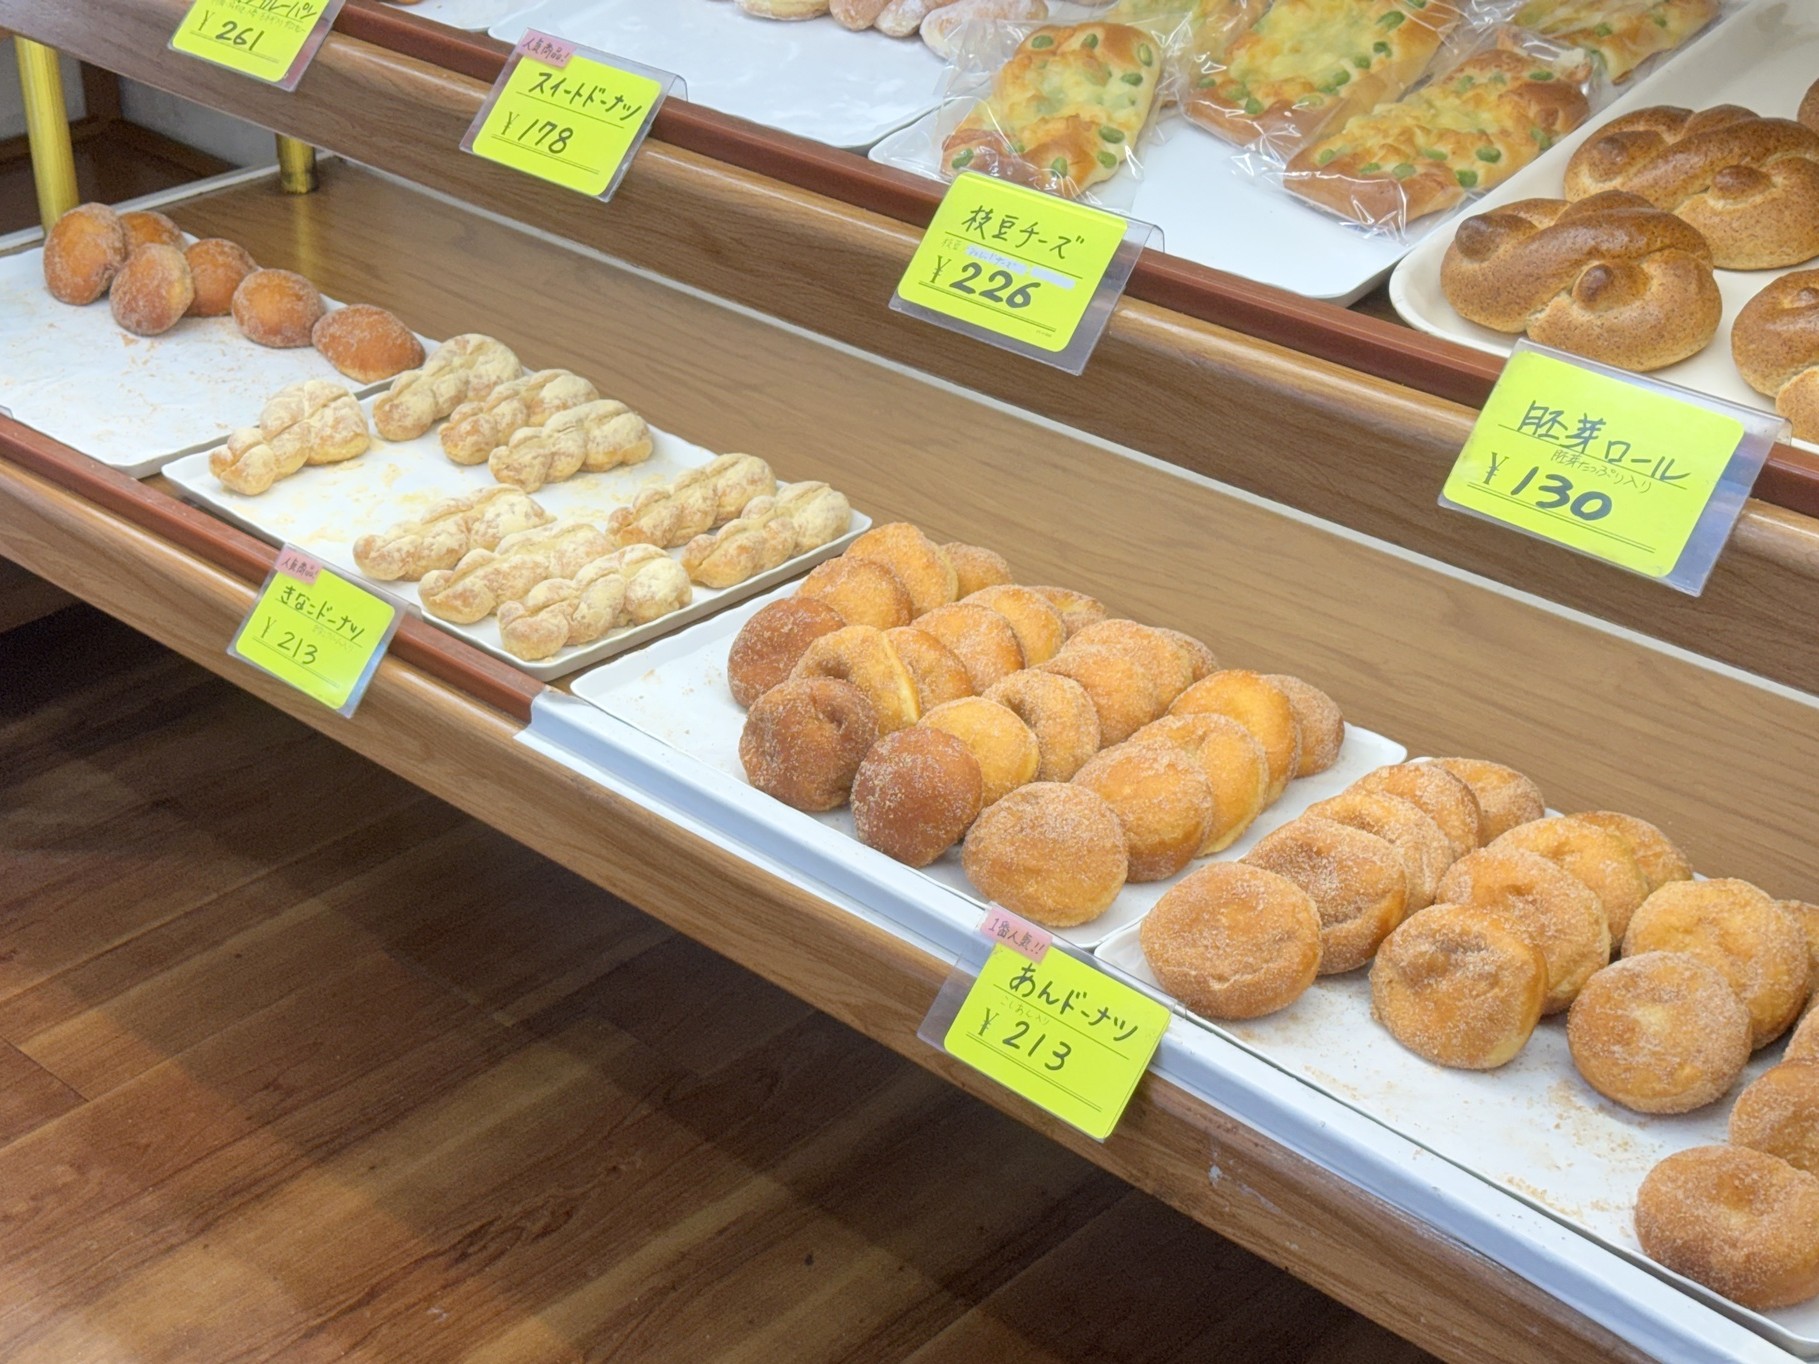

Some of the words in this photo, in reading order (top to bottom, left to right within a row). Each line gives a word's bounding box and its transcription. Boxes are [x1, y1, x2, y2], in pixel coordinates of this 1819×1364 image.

[528, 72, 643, 121] スイートドーナツ
[961, 204, 1085, 260] 枝豆チーズ
[1516, 400, 1691, 482] 胚芽ロール
[280, 585, 365, 641] きなこドーナツ
[1009, 962, 1139, 1042] あんドーナツ
